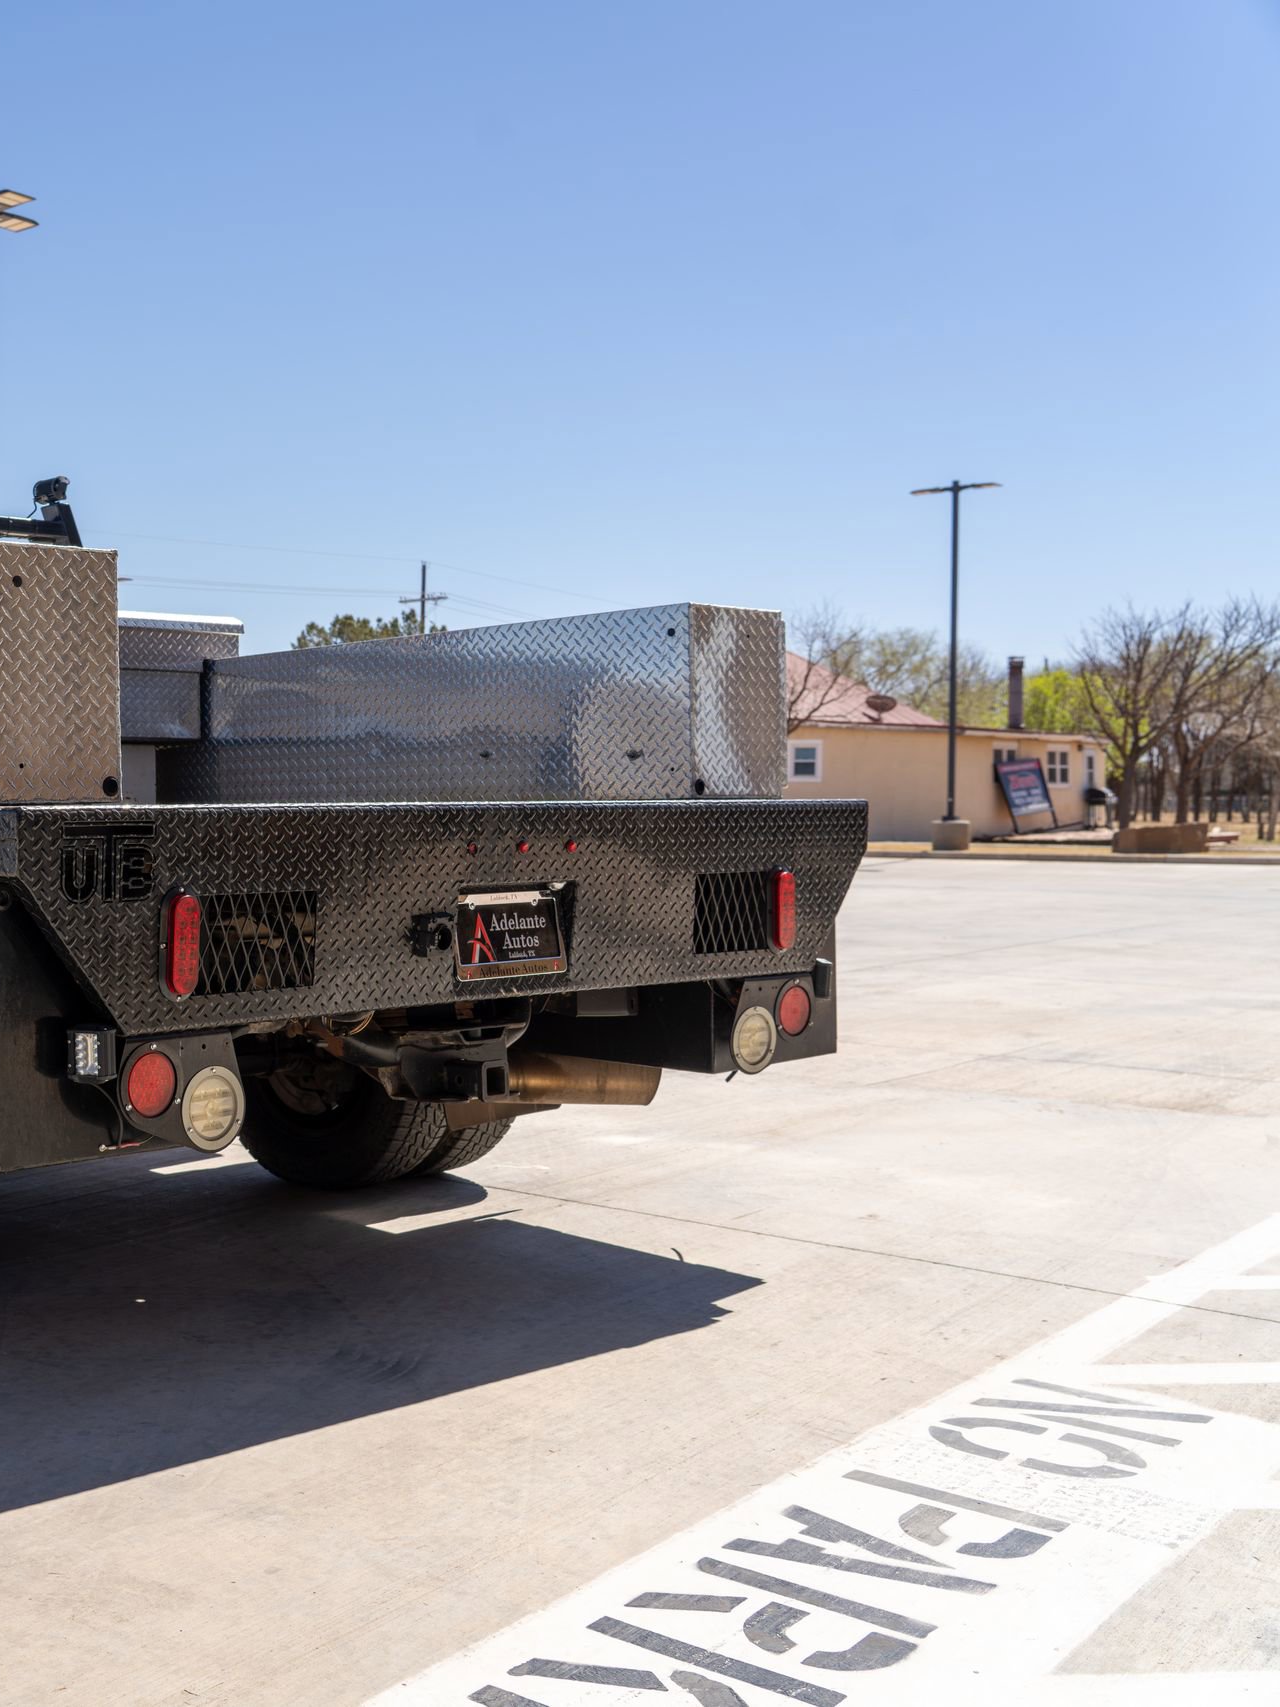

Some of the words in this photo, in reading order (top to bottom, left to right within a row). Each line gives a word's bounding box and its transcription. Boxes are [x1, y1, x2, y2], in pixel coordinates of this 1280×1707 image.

[489, 912, 547, 932] Adelante
[502, 931, 540, 950] Autos
[479, 965, 520, 977] Adelante
[520, 963, 548, 974] Autos
[928, 1378, 1214, 1479] NO
